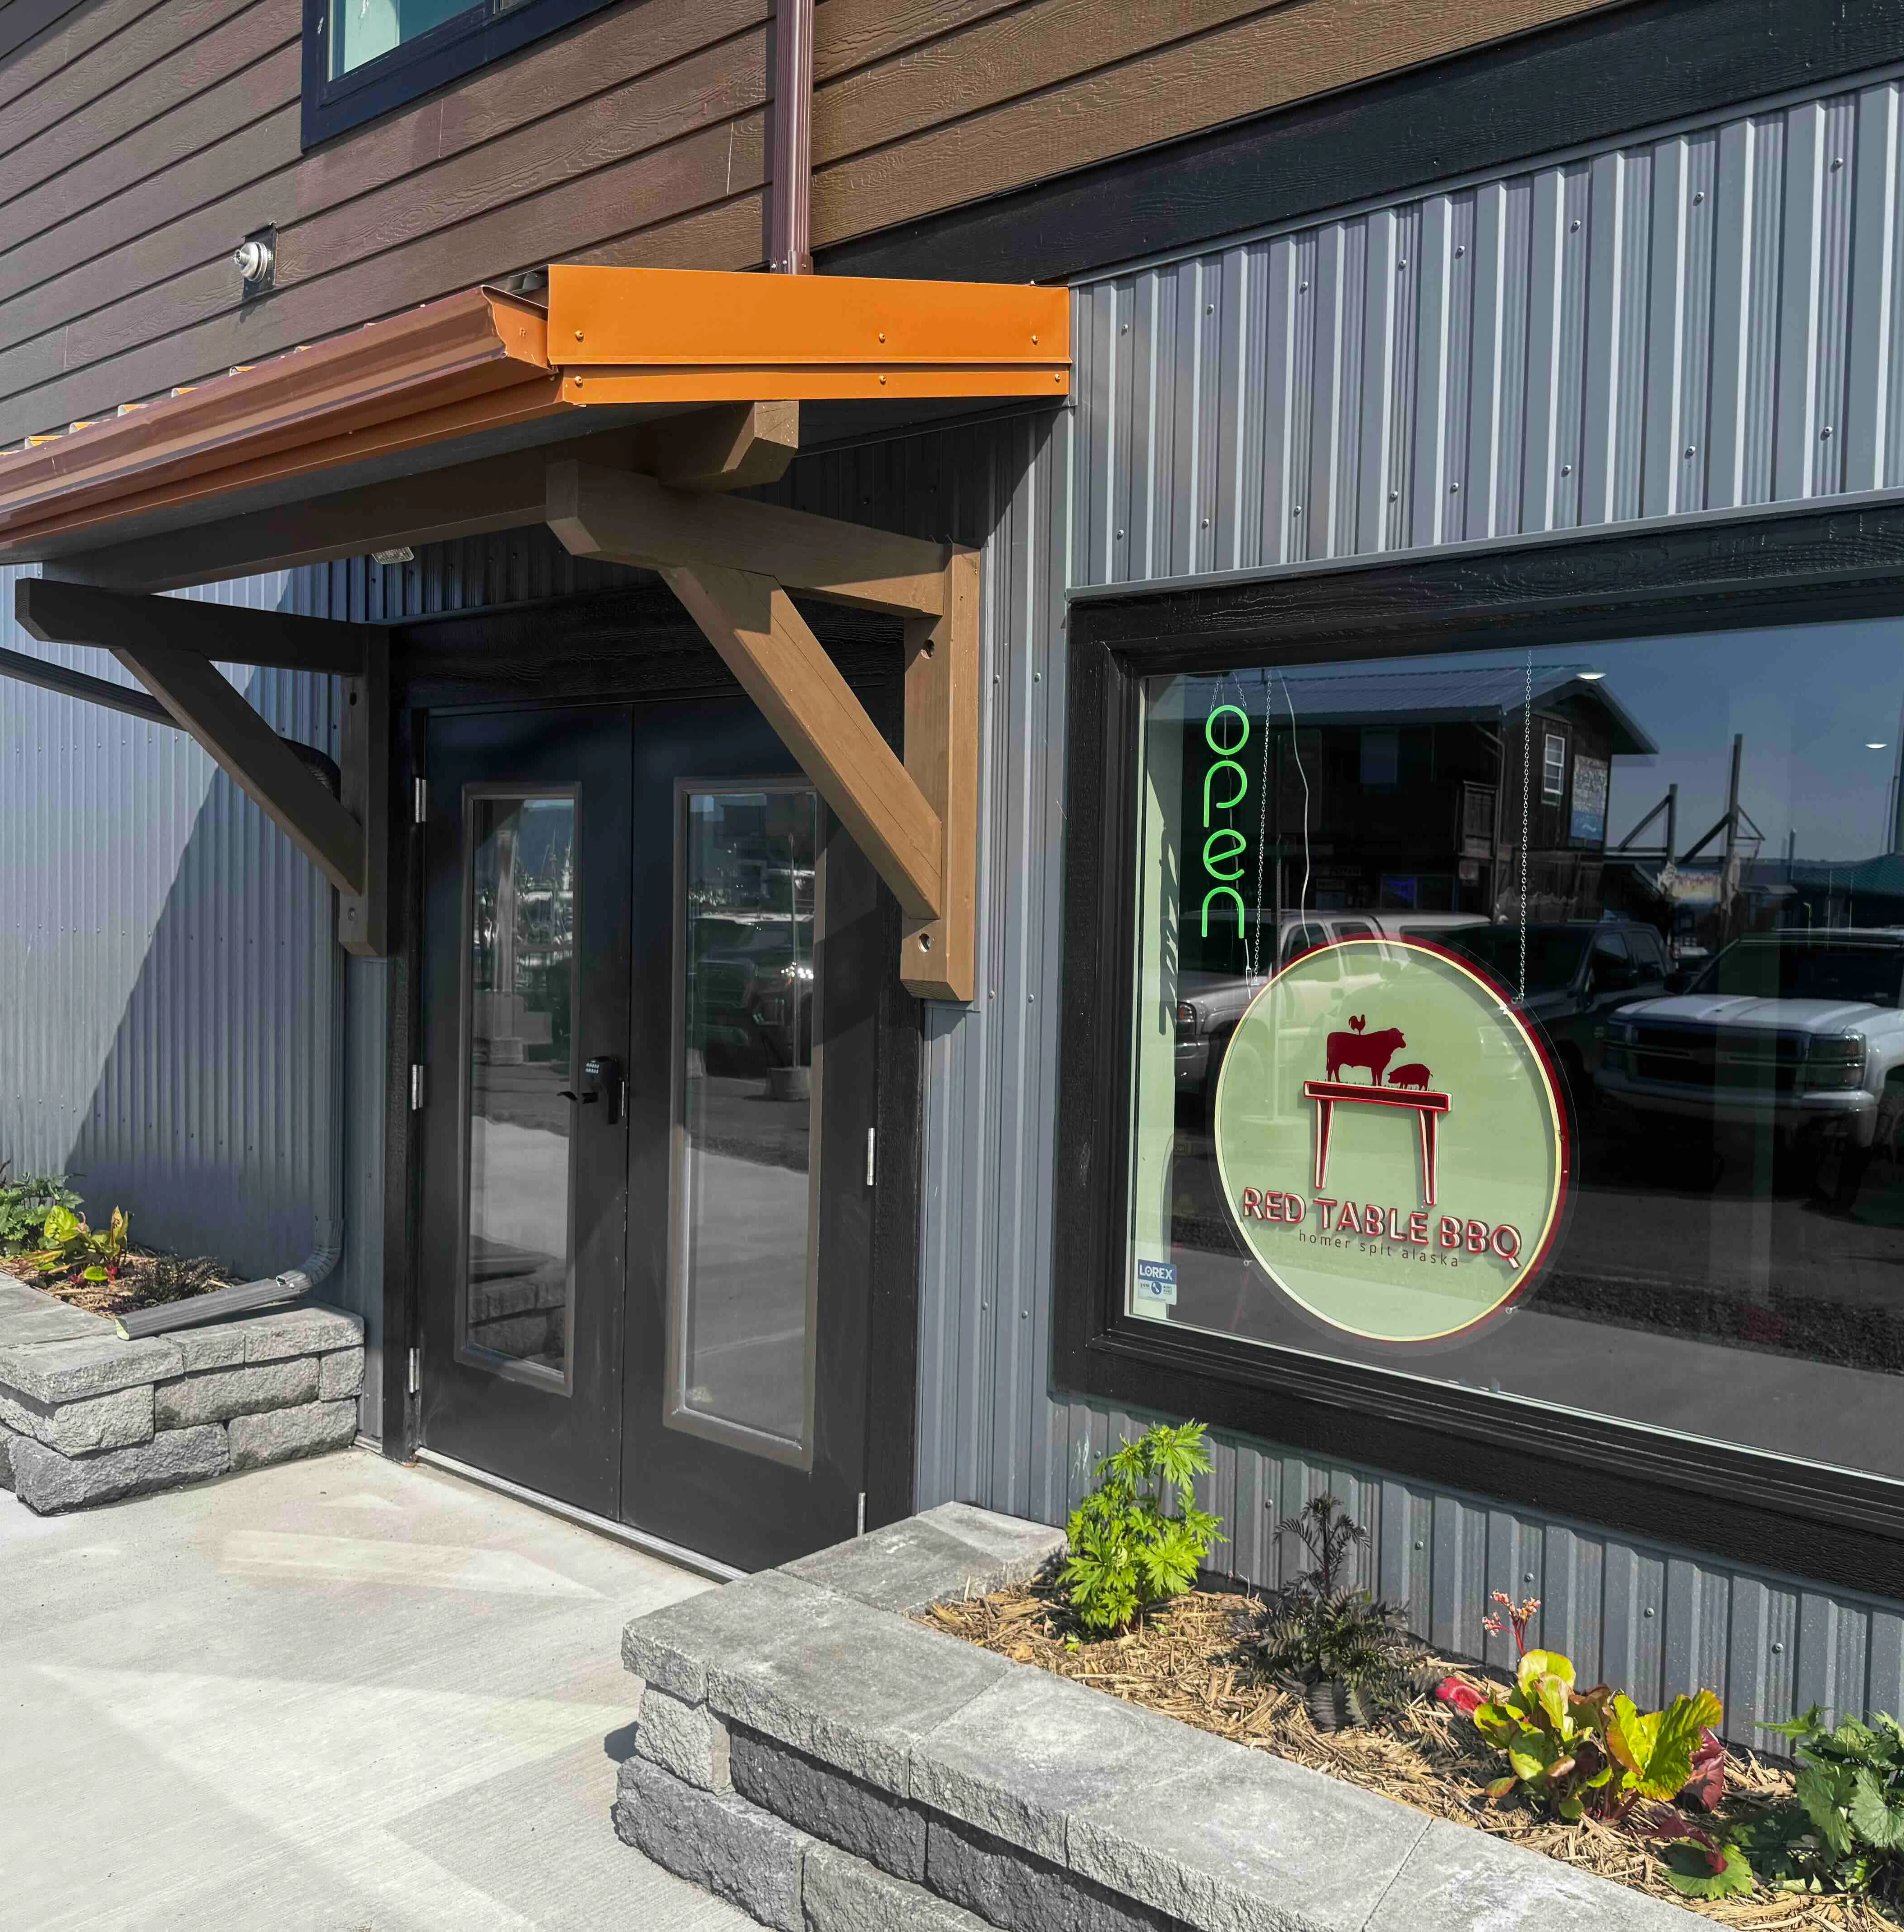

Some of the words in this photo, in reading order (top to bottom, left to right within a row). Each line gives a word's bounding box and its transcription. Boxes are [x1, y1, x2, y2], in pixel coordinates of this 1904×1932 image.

[1202, 704, 1249, 938] open
[1243, 1187, 1306, 1224] RED
[1313, 1197, 1429, 1245] TABLE
[1439, 1215, 1522, 1269] BBQ
[1299, 1229, 1351, 1249] homer
[1360, 1242, 1392, 1256] spit
[1401, 1249, 1458, 1267] alaska
[1139, 1264, 1173, 1281] LOREX
